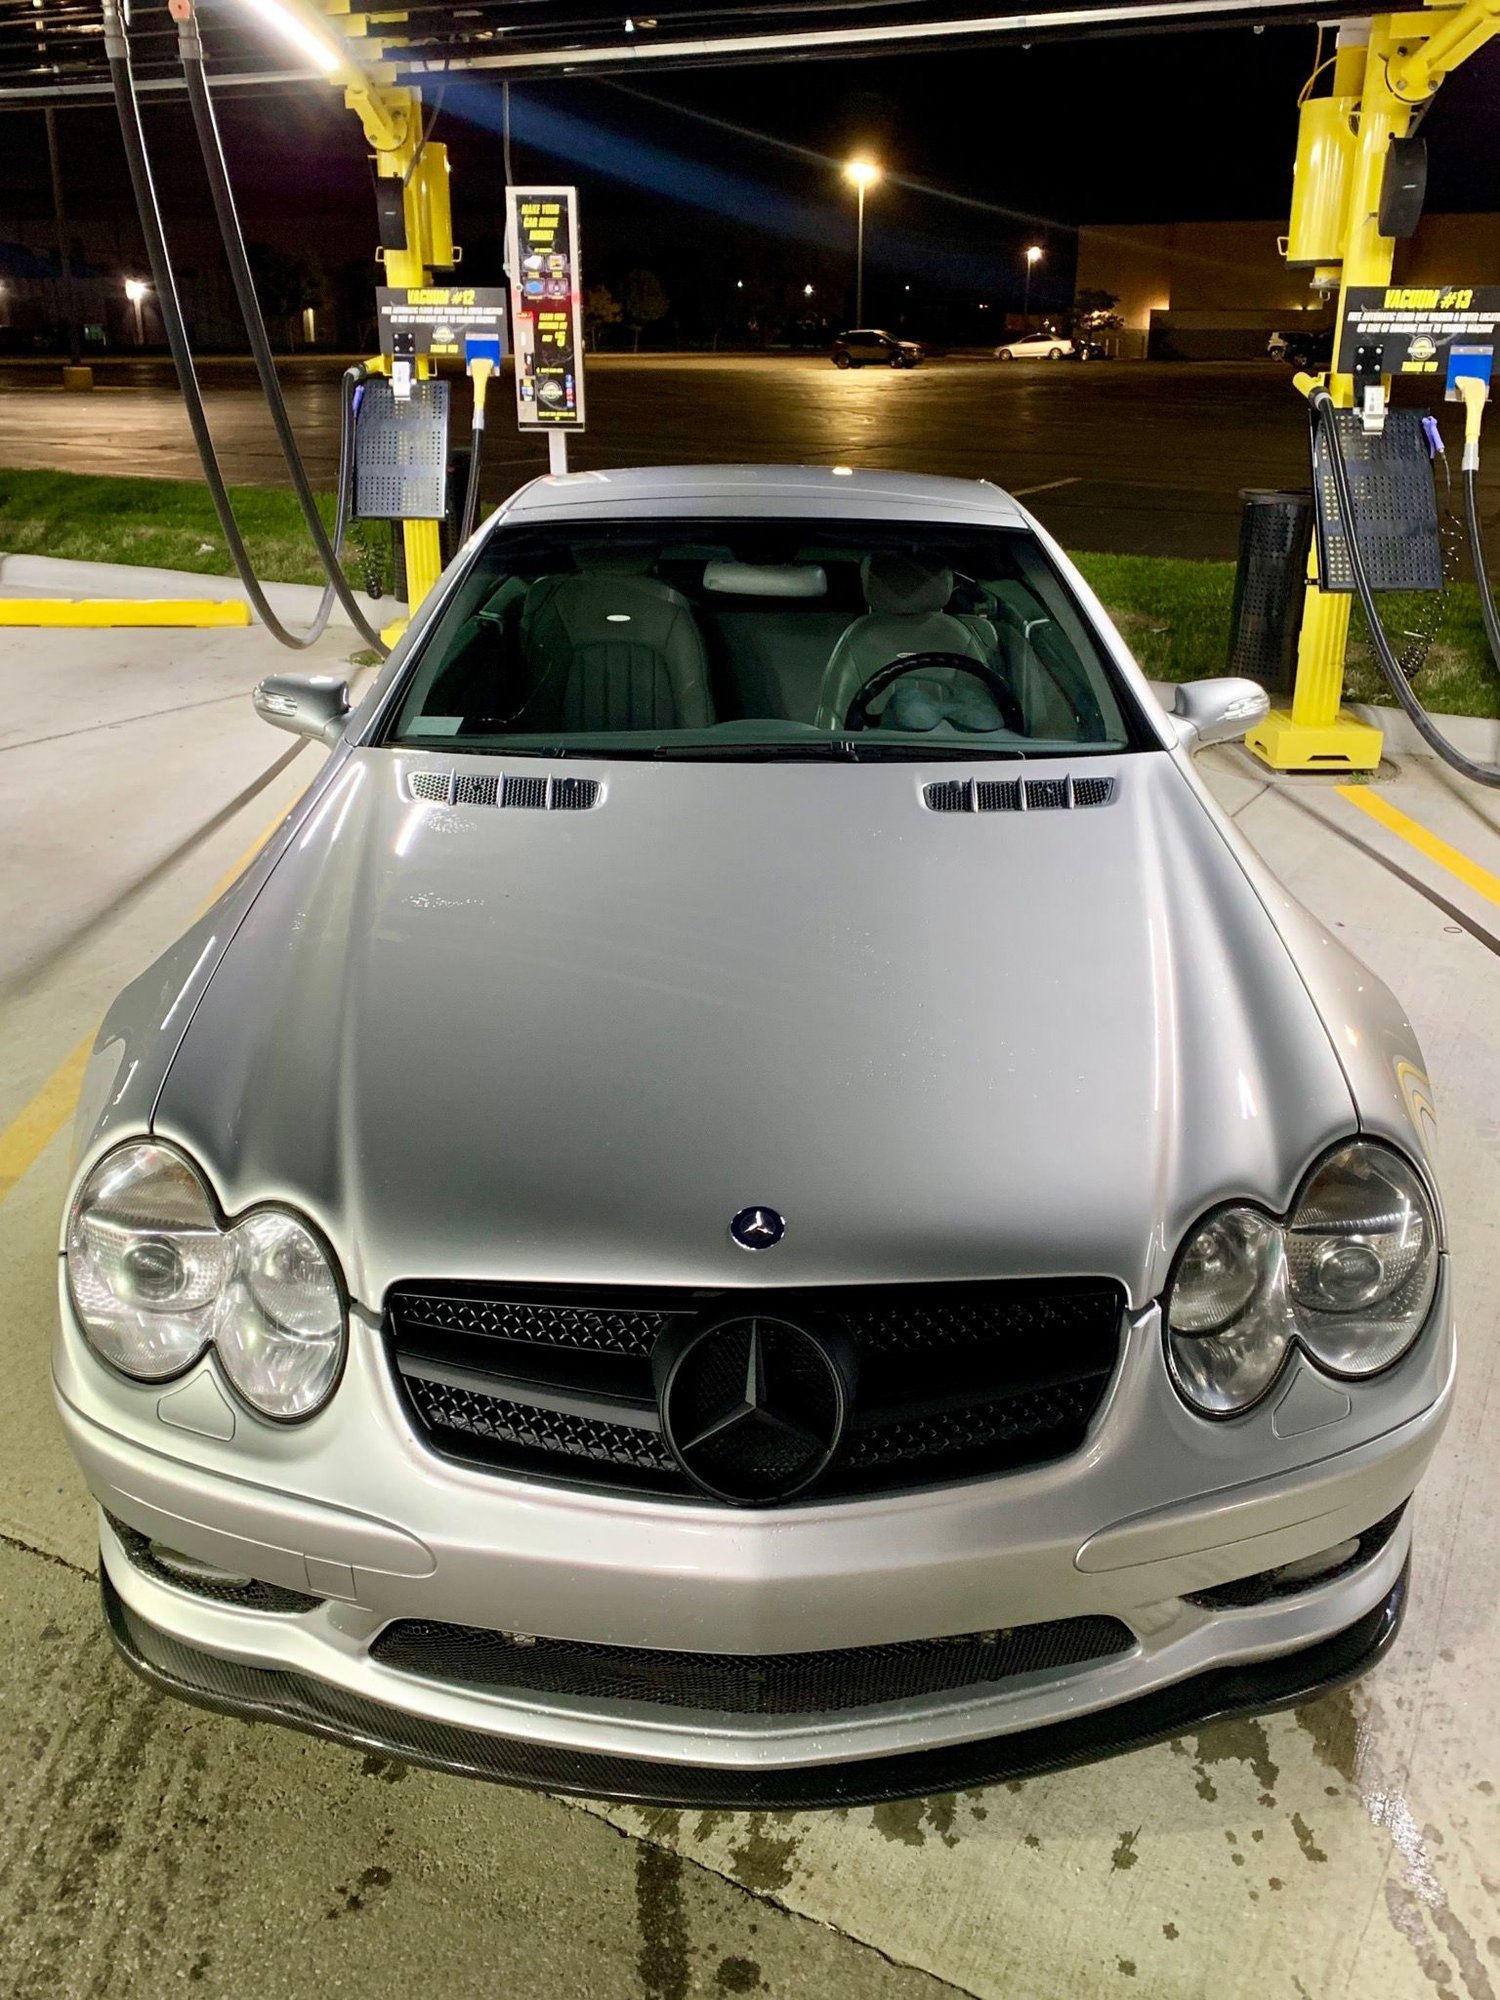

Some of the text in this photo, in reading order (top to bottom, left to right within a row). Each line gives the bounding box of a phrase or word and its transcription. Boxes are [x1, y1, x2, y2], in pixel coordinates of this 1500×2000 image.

[521, 203, 541, 215] MAKE
[407, 289, 475, 305] VACUUM #12
[1384, 289, 1473, 309] VACUUM #13
